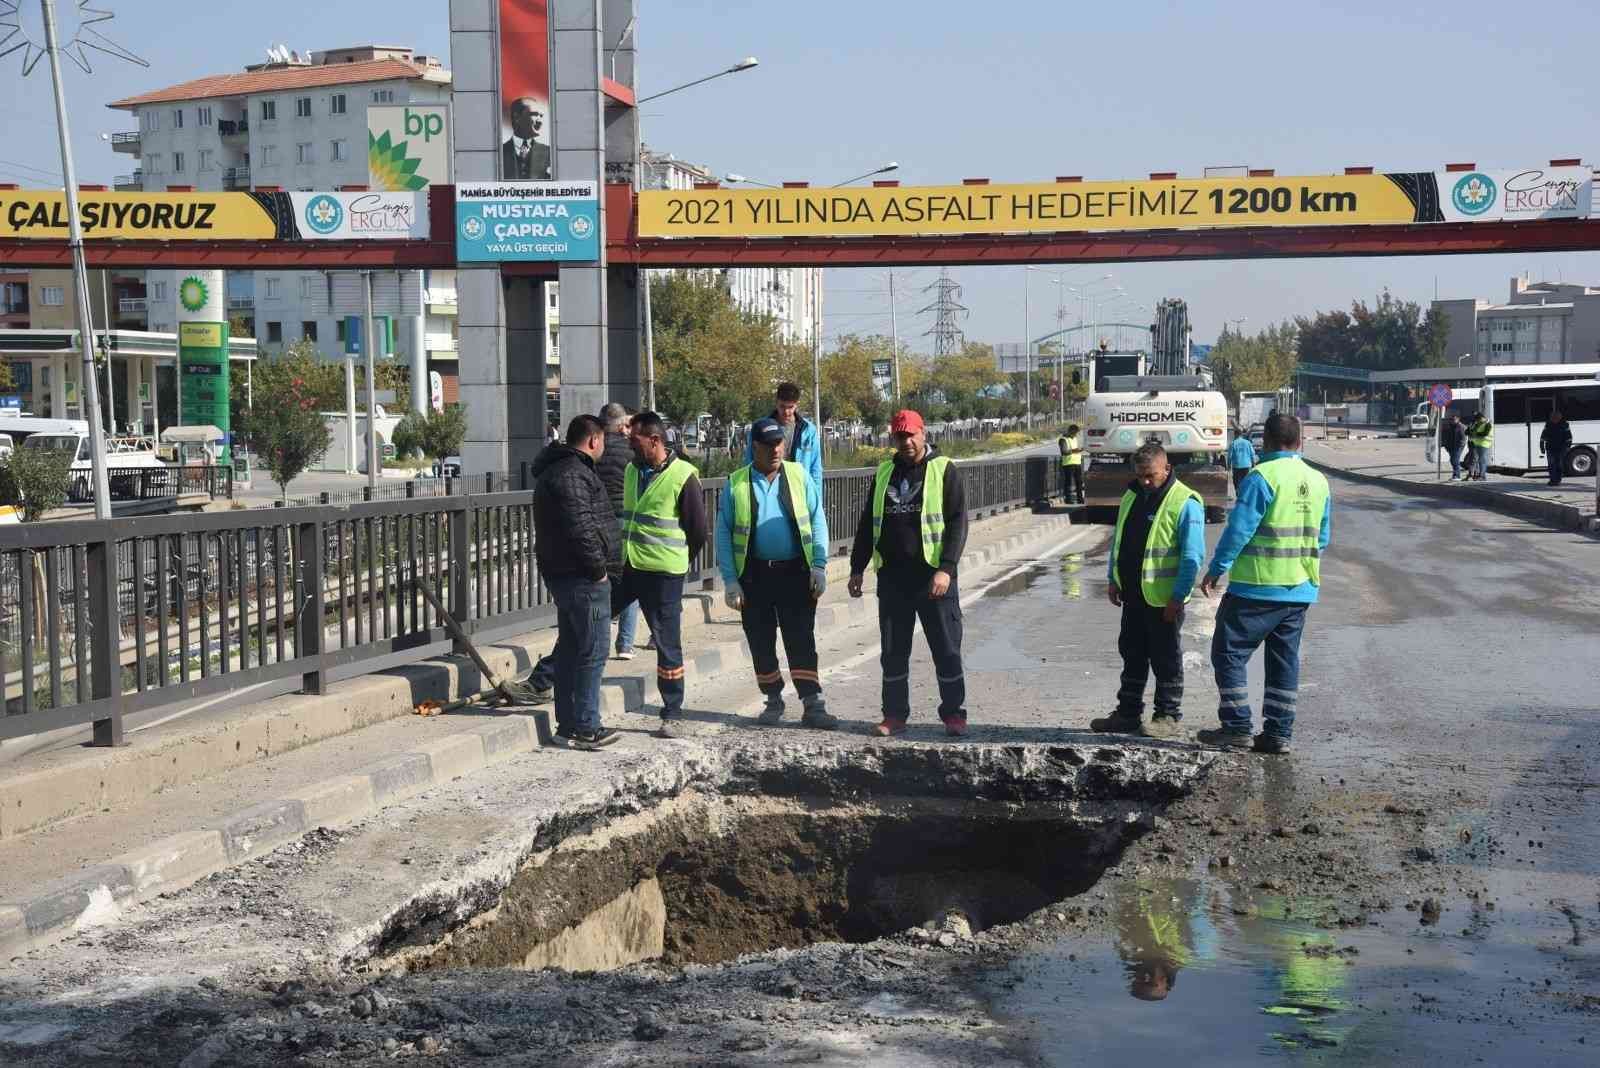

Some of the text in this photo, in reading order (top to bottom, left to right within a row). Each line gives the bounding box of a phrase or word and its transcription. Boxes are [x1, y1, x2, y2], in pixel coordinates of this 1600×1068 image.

[404, 108, 443, 143] bp
[461, 187, 592, 199] MANİSA BÜYÜKŞEHİR BELEDİYESİ
[482, 204, 569, 218] MUSTAFA
[667, 184, 1357, 224] 2021 YILINDA ASFALT HEDEFİMİZ 1200 km
[8, 201, 216, 232] ÇALŞIYORUZ
[494, 223, 558, 241] ÇAPRA
[486, 242, 568, 254] YAYA ÜST GEÇİDİ
